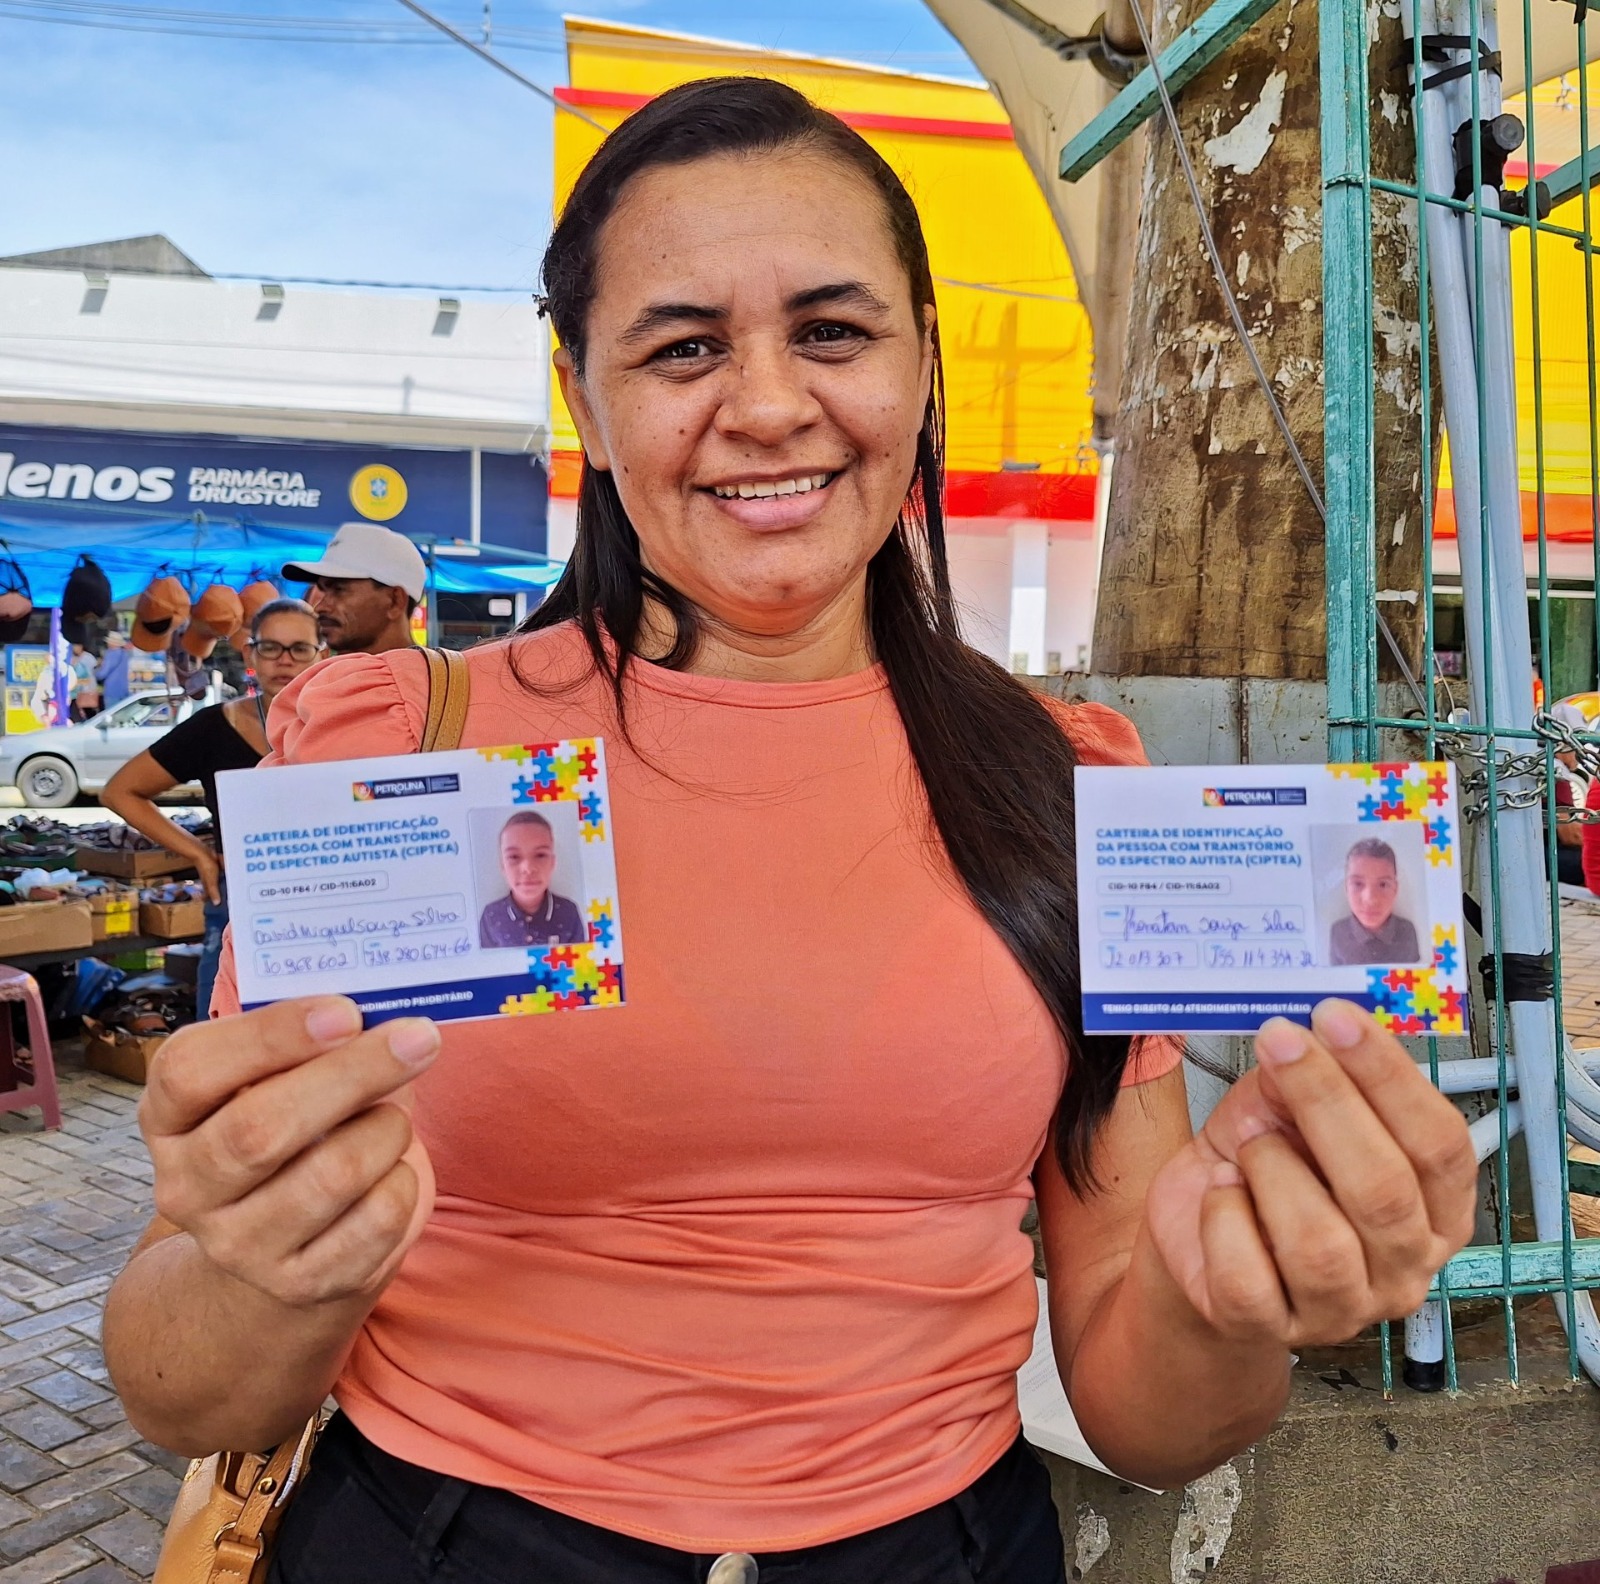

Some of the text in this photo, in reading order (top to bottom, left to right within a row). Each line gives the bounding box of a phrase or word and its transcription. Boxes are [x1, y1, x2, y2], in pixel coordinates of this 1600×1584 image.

[0, 452, 176, 503] enos
[188, 467, 306, 490] FARMÁCIA
[188, 487, 321, 508] DRUGSTORE
[374, 780, 426, 795] PETROLINA
[1224, 791, 1275, 805] PETROLINA
[244, 814, 439, 844] CARTEIRA DE IDENTIFICAÇÃO
[1096, 824, 1284, 839] CARTEIRA DE IDENTIFICAÇÃO
[245, 829, 451, 859] DA PESSOA COM TRANSTORNO
[1096, 841, 1294, 852] DA PESSOA COM TRANSTORNO
[247, 841, 460, 873] DO ESPECTRO AUTISTA (CIPTEA)
[1096, 853, 1302, 868] DO ESPECTRO AUTISTA (CIPTEA)
[260, 886, 291, 897] CID-10
[1107, 882, 1138, 890] CID-10
[411, 990, 474, 1007] PRIORITÁRIO
[1101, 1001, 1313, 1015] TENHO DIREITO AO ATENDIMENTO PRIORITÁRIO
